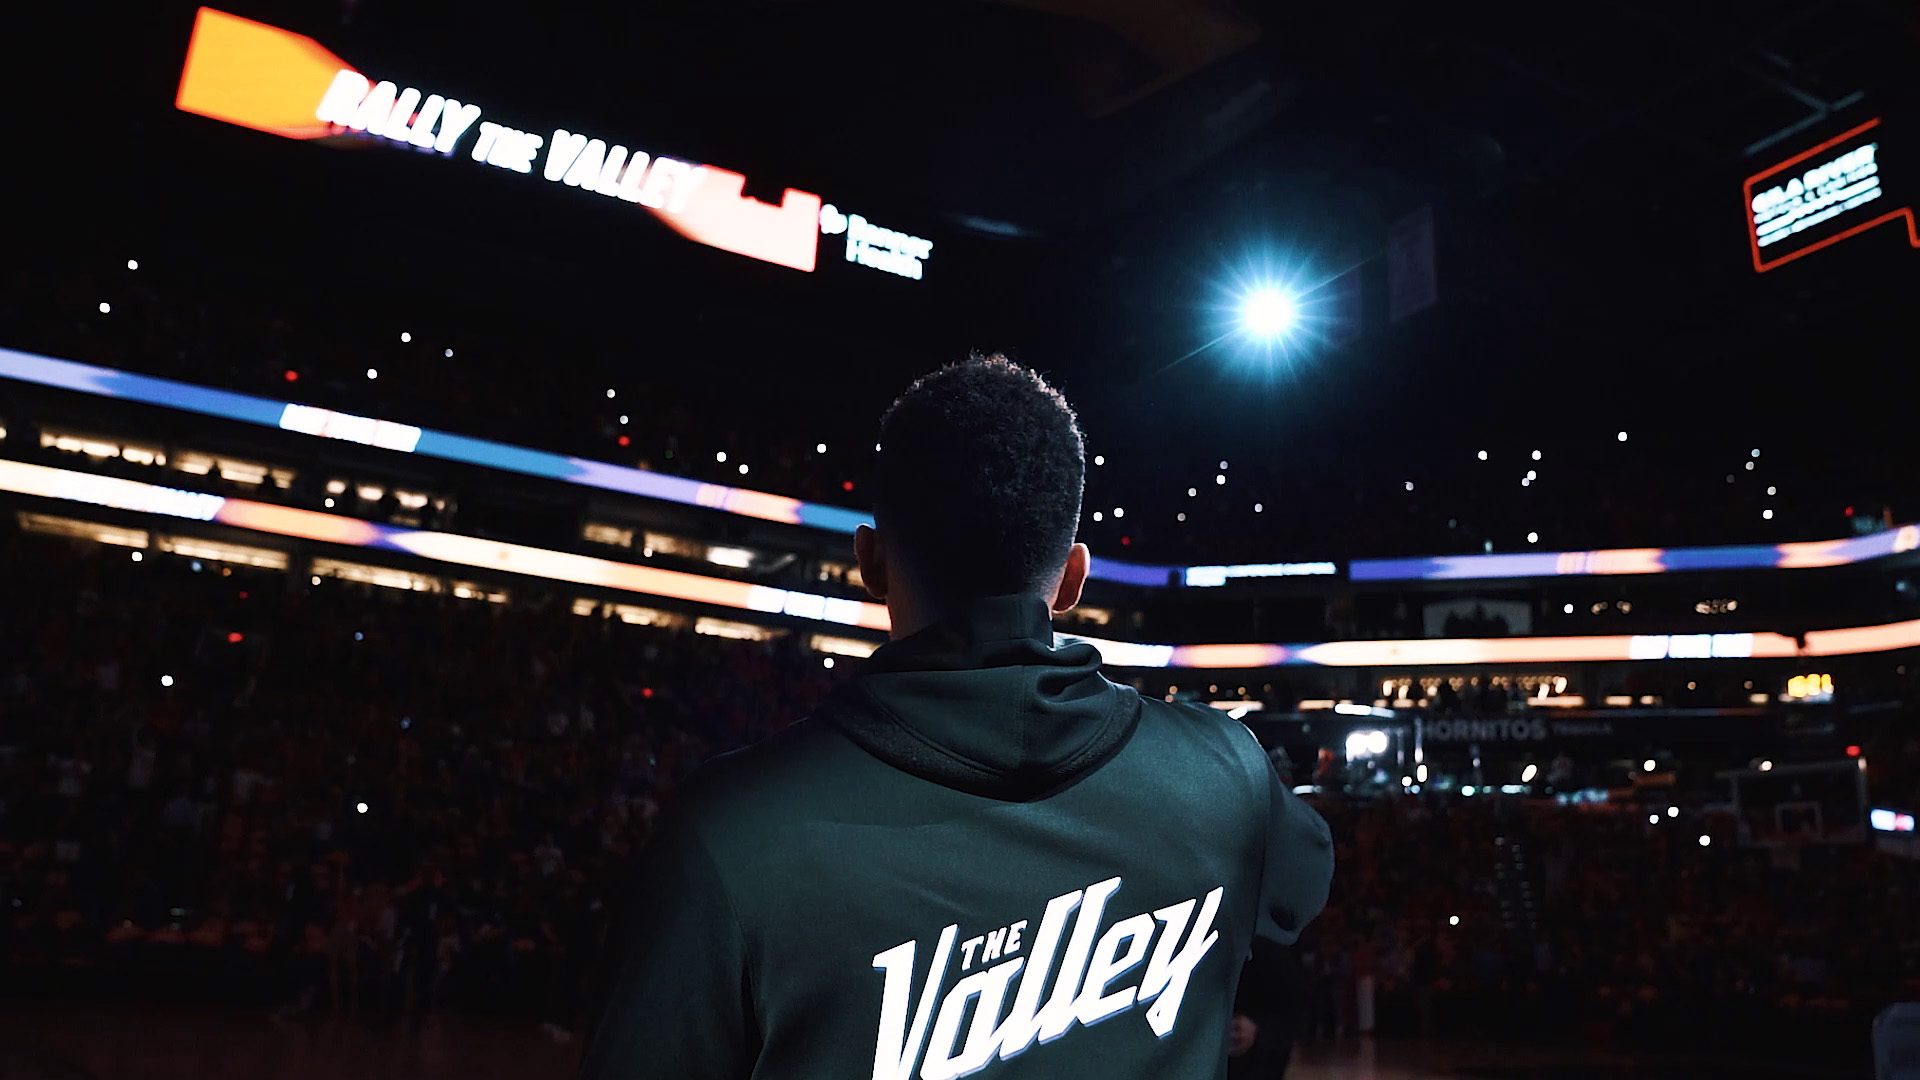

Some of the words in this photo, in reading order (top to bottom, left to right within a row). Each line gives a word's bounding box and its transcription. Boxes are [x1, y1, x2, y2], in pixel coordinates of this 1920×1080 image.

[315, 69, 481, 153] RALLY
[472, 121, 543, 173] THE
[544, 129, 706, 213] VALLEY
[872, 876, 1224, 1080] Valley
[961, 920, 1028, 971] THE
